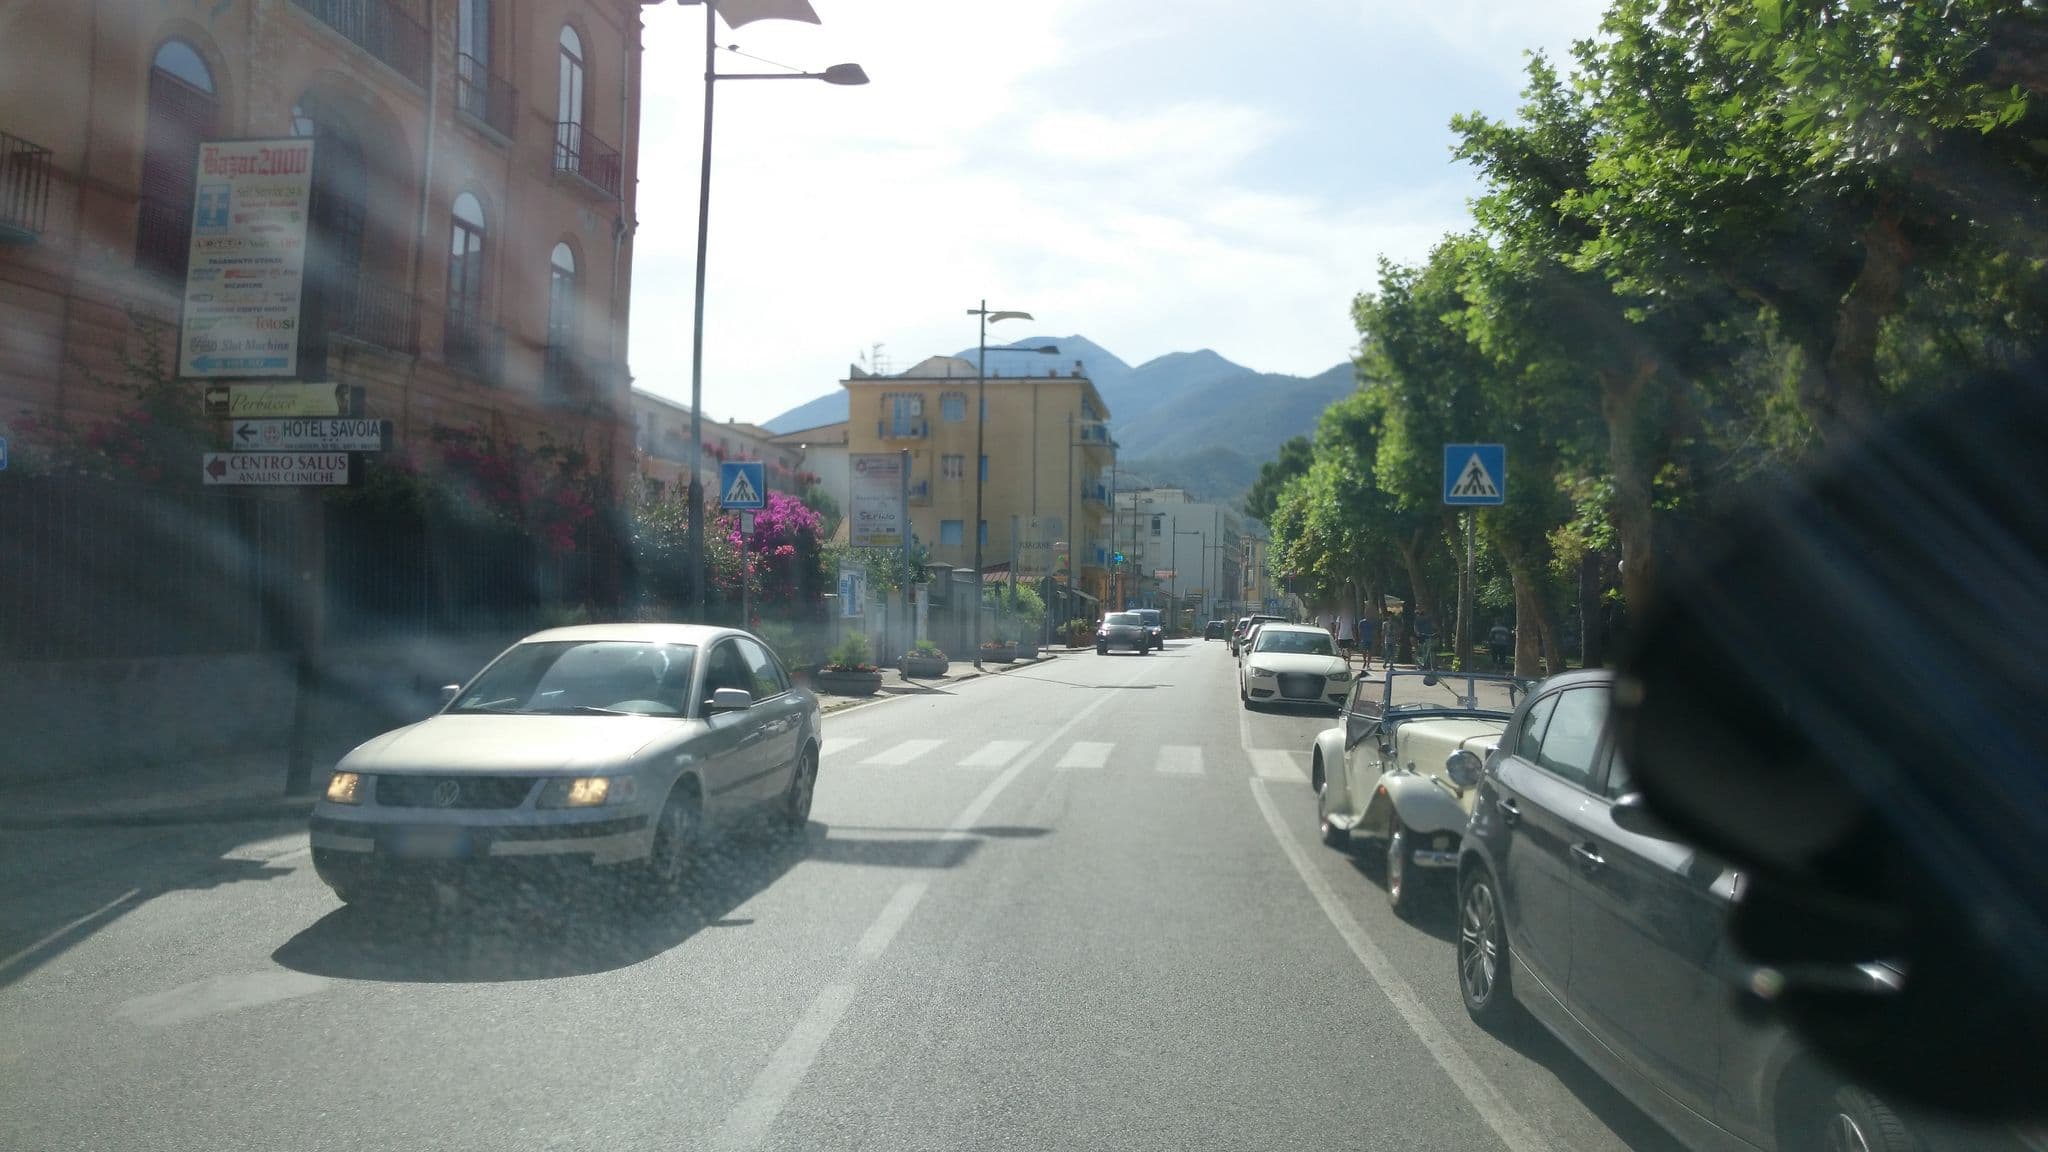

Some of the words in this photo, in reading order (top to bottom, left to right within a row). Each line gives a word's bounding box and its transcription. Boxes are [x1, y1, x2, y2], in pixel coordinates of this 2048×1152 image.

[283, 421, 327, 437] HOTEL
[331, 420, 380, 437] SAVOIA
[230, 456, 293, 470] CENTRO
[299, 455, 346, 470] SALUS
[239, 471, 281, 483] ANALISI
[283, 471, 335, 483] CLINICHE
